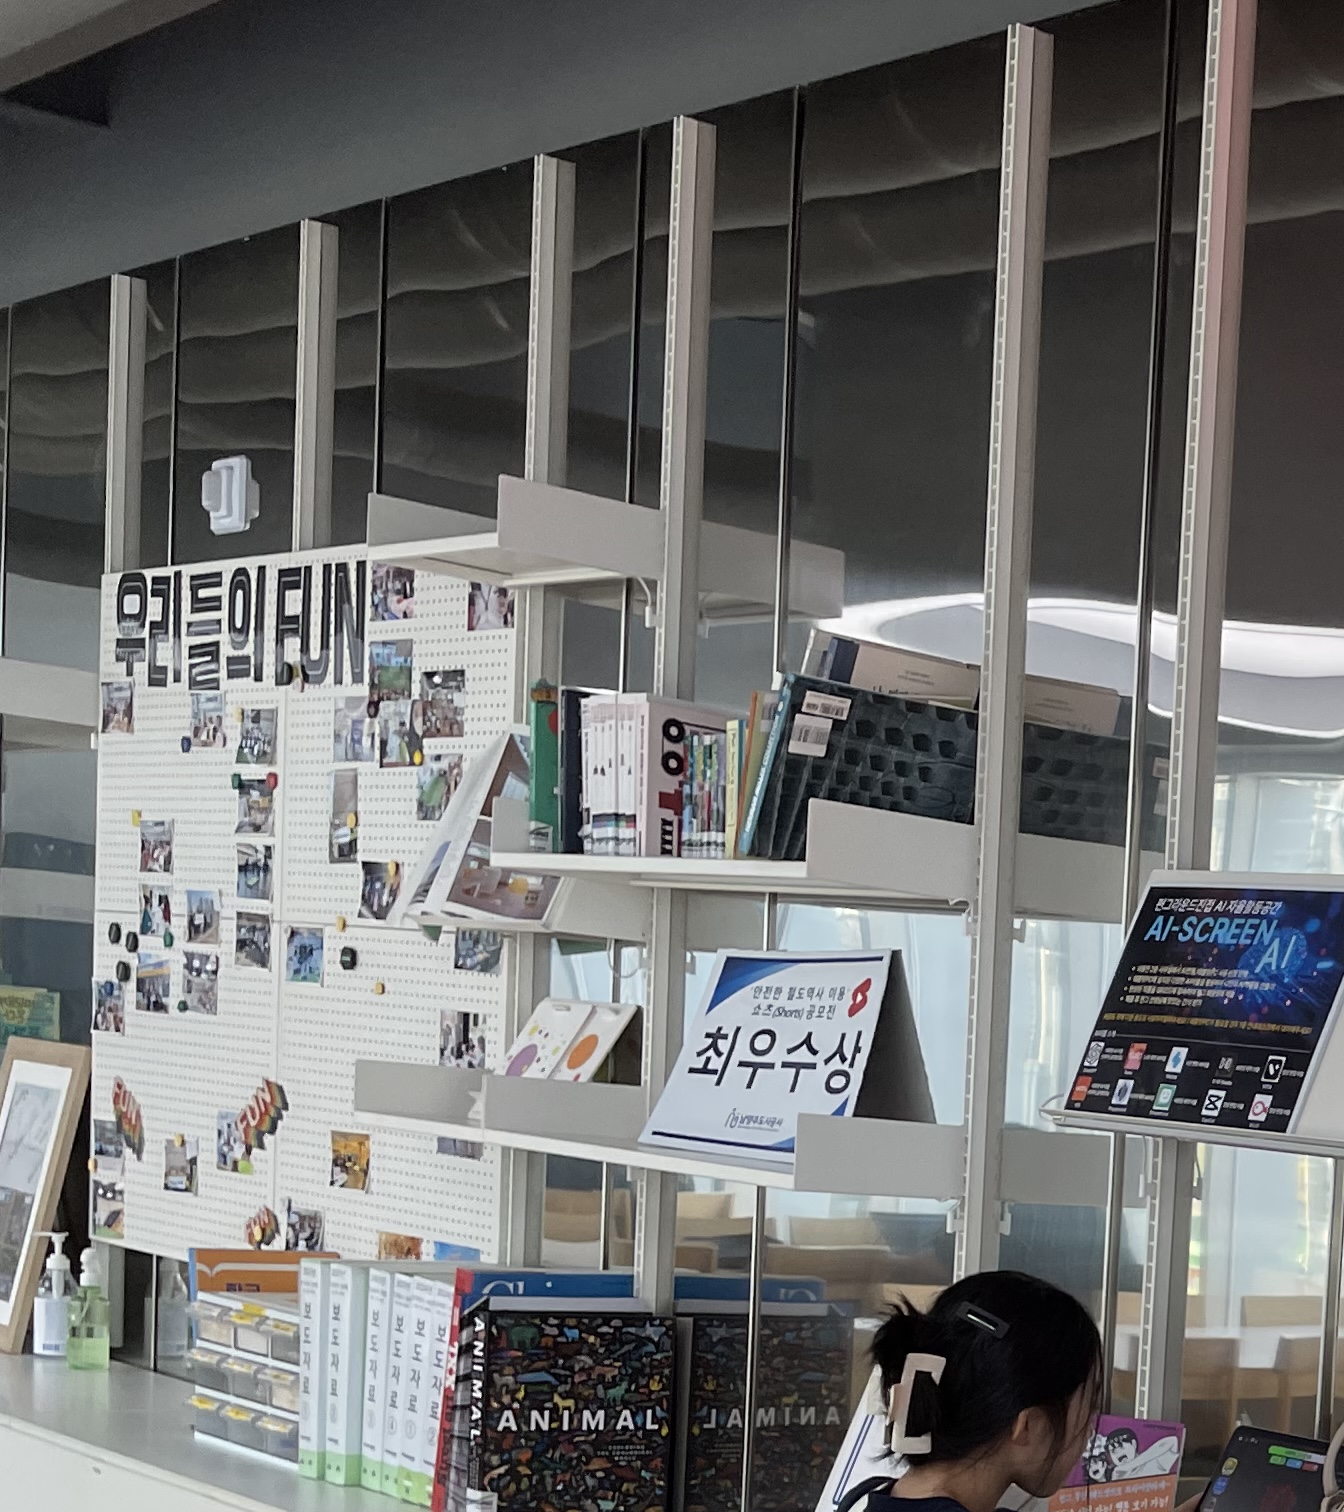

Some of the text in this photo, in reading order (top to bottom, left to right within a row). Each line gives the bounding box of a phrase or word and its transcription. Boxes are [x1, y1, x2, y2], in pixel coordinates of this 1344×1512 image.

[115, 560, 367, 690] 우리들의 FUN
[1144, 915, 1278, 946] AI-SCREEN
[1213, 900, 1227, 912] AI
[1254, 934, 1297, 973] AI
[806, 1004, 836, 1020] 공모전
[687, 1025, 863, 1095] 최우수상
[302, 1302, 312, 1395] 보도자료
[330, 1304, 341, 1397] 보도자료
[367, 1310, 379, 1403] 보도자료
[389, 1315, 404, 1409] 보도자료
[408, 1318, 426, 1414] 보도자료
[429, 1325, 447, 1421] 보도자료
[470, 1316, 486, 1441] ANIMAL
[497, 1409, 659, 1432] ANIMAL
